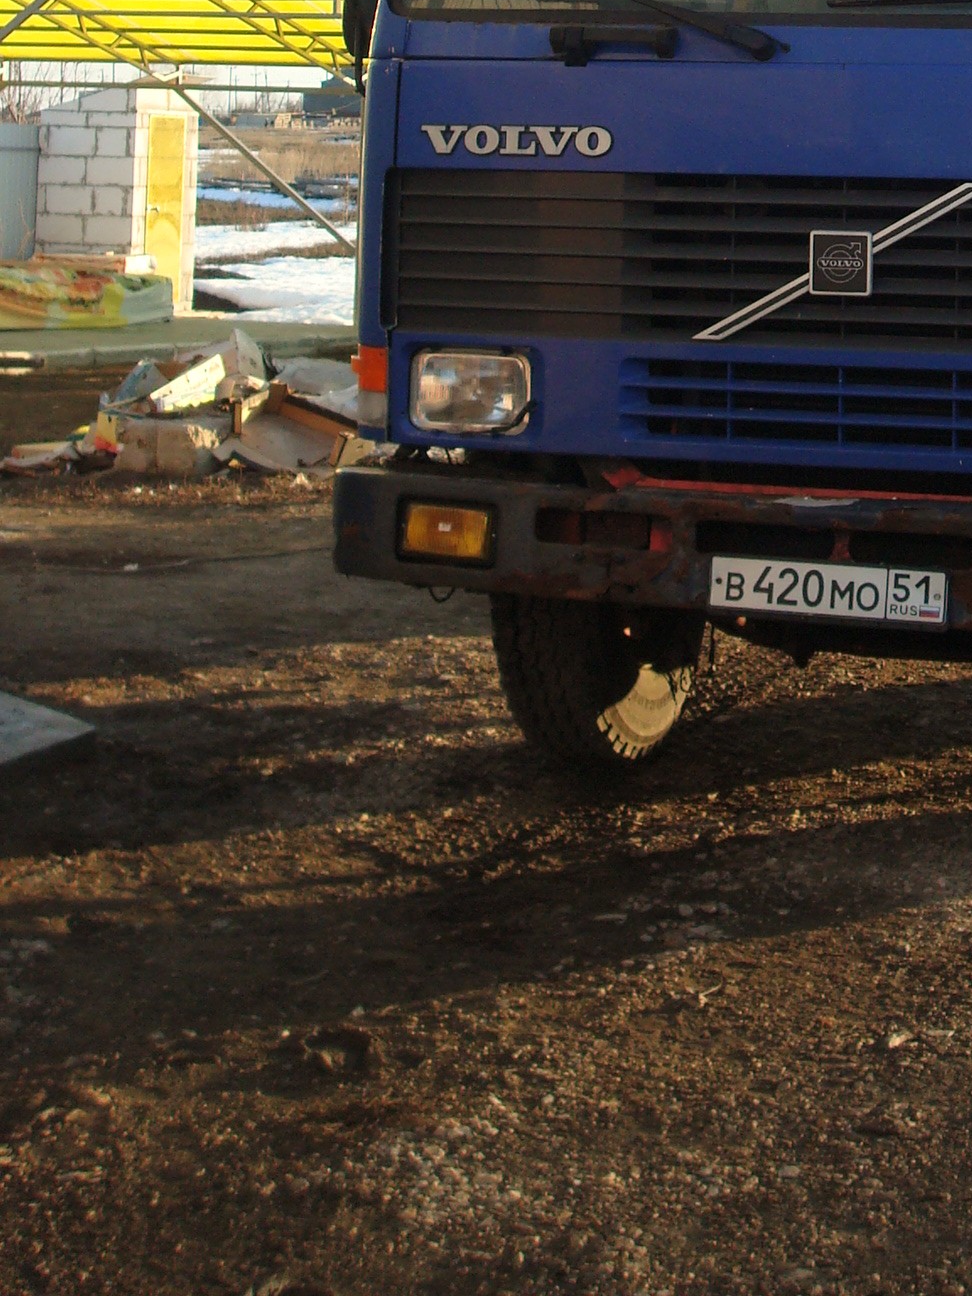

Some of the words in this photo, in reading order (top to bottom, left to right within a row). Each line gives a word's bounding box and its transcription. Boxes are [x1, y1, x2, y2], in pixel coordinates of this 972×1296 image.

[420, 124, 613, 157] VOLVO
[820, 258, 862, 268] VOLVO
[891, 572, 932, 605] 51
[889, 604, 918, 616] RUS
